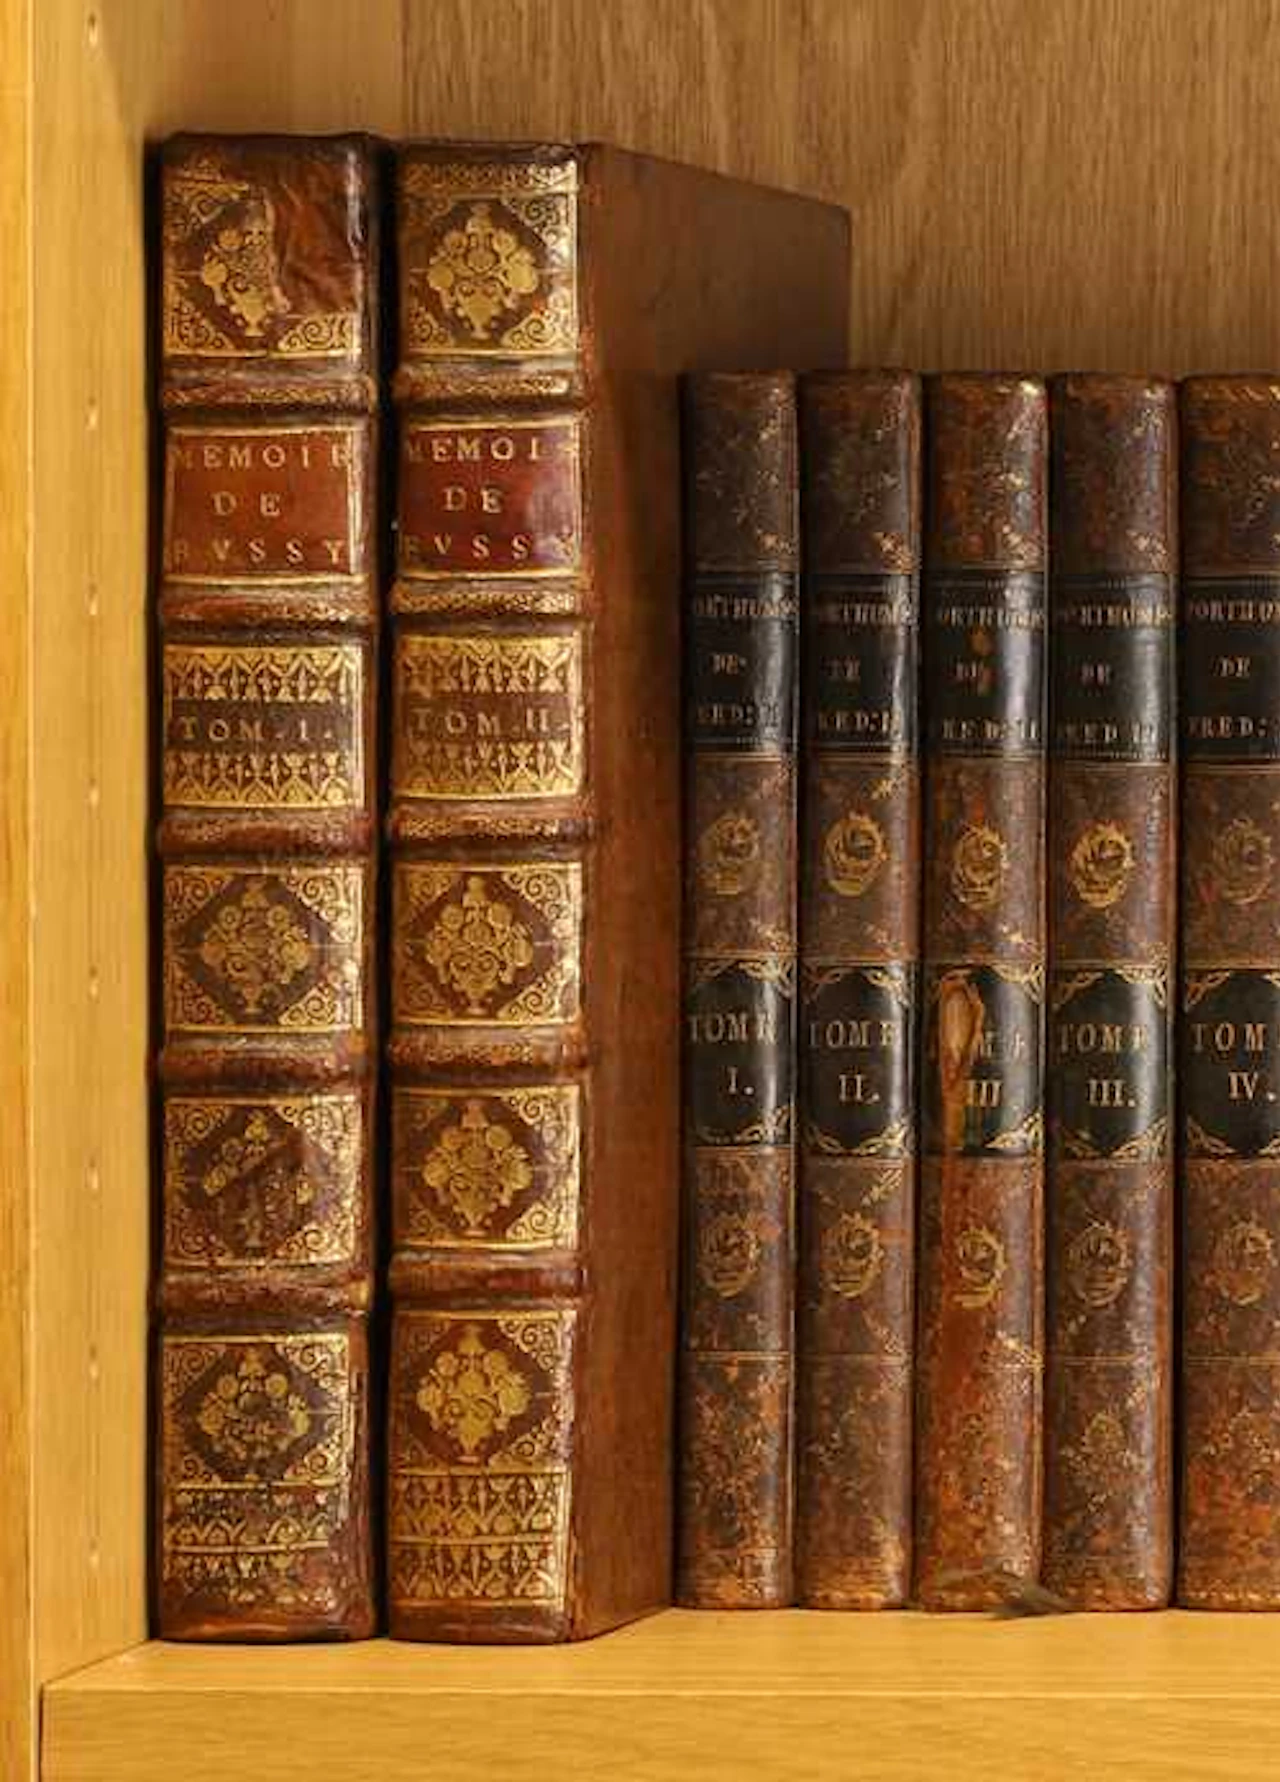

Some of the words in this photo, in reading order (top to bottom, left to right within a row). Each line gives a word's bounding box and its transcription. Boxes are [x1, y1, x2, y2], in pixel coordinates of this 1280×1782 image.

[405, 437, 560, 463] MEMOI
[213, 491, 282, 518] DE
[444, 487, 502, 514] DE
[1085, 1077, 1137, 1108] III.
[1228, 1071, 1277, 1103] IV.
